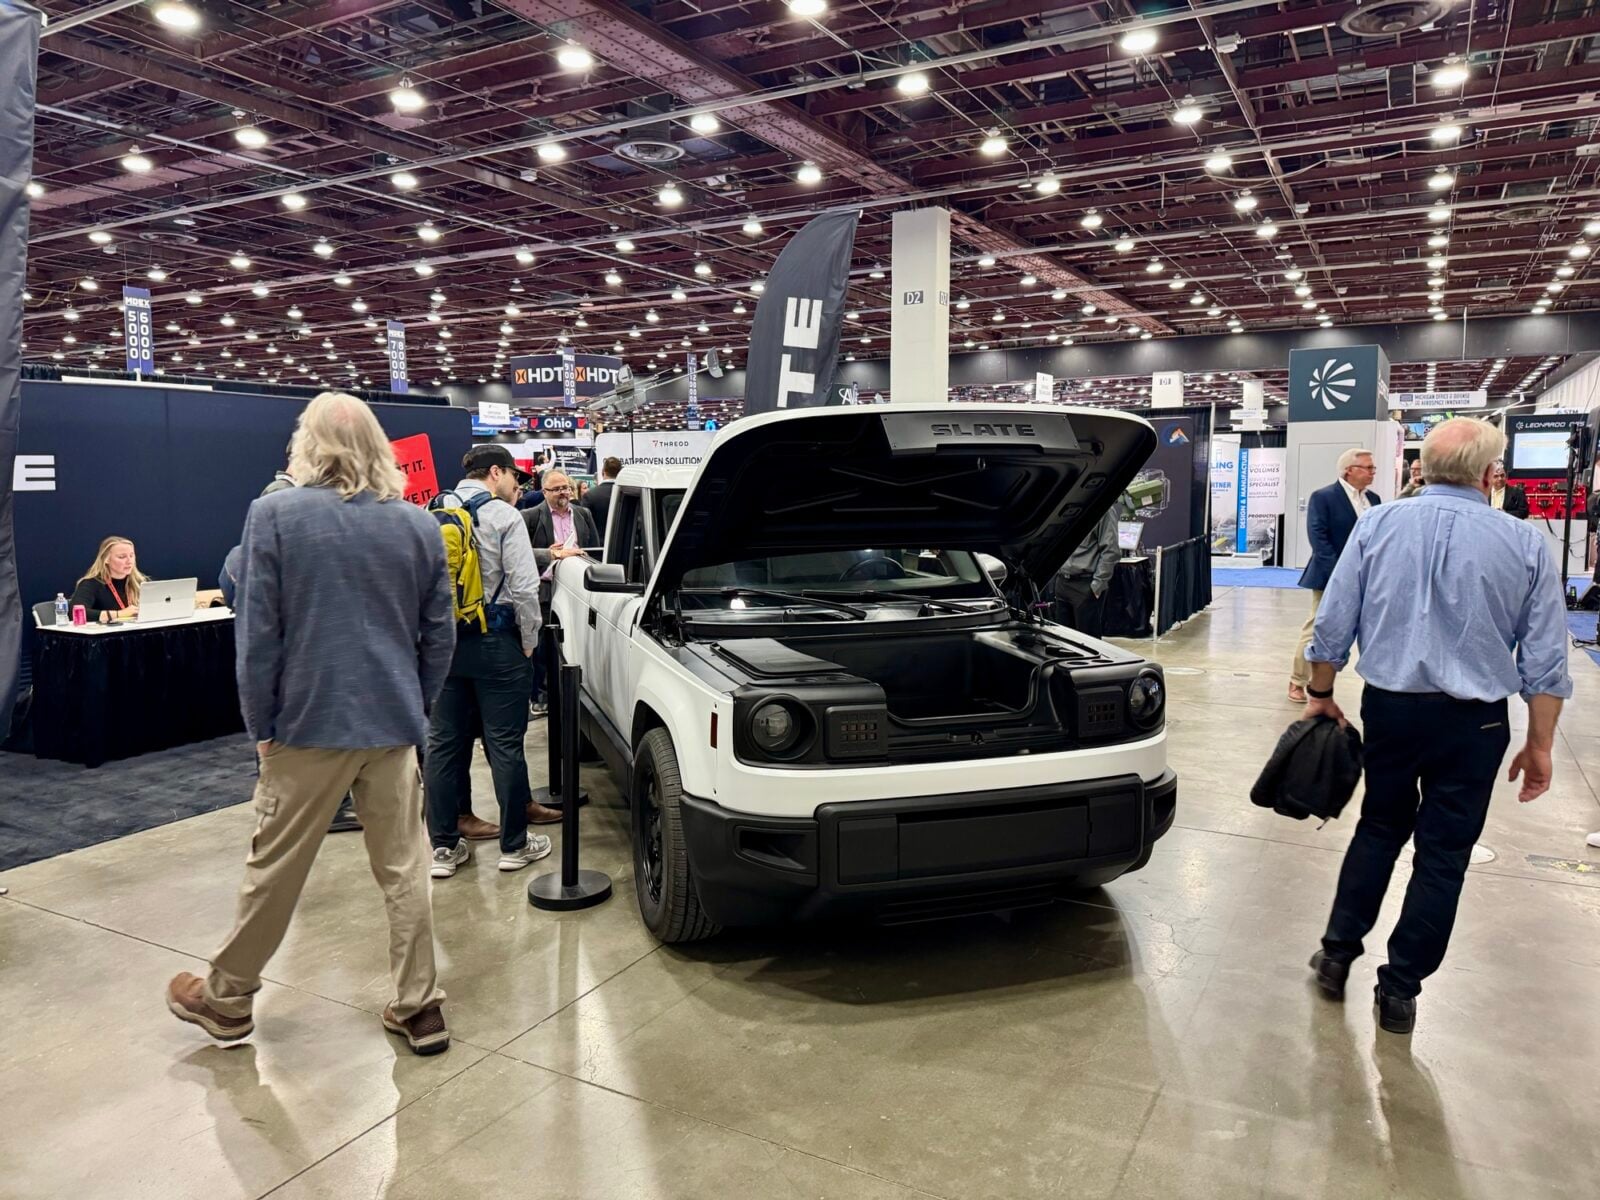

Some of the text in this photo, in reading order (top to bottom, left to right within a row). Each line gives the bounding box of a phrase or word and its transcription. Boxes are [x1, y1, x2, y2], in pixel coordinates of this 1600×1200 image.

[906, 292, 921, 305] D2
[527, 367, 564, 383] HDT
[586, 367, 619, 384] HDT
[544, 418, 572, 428] Ohio
[931, 423, 1035, 436] SLATE
[1525, 421, 1566, 429] LEONARDO
[412, 459, 426, 473] IT.
[13, 455, 56, 491] E
